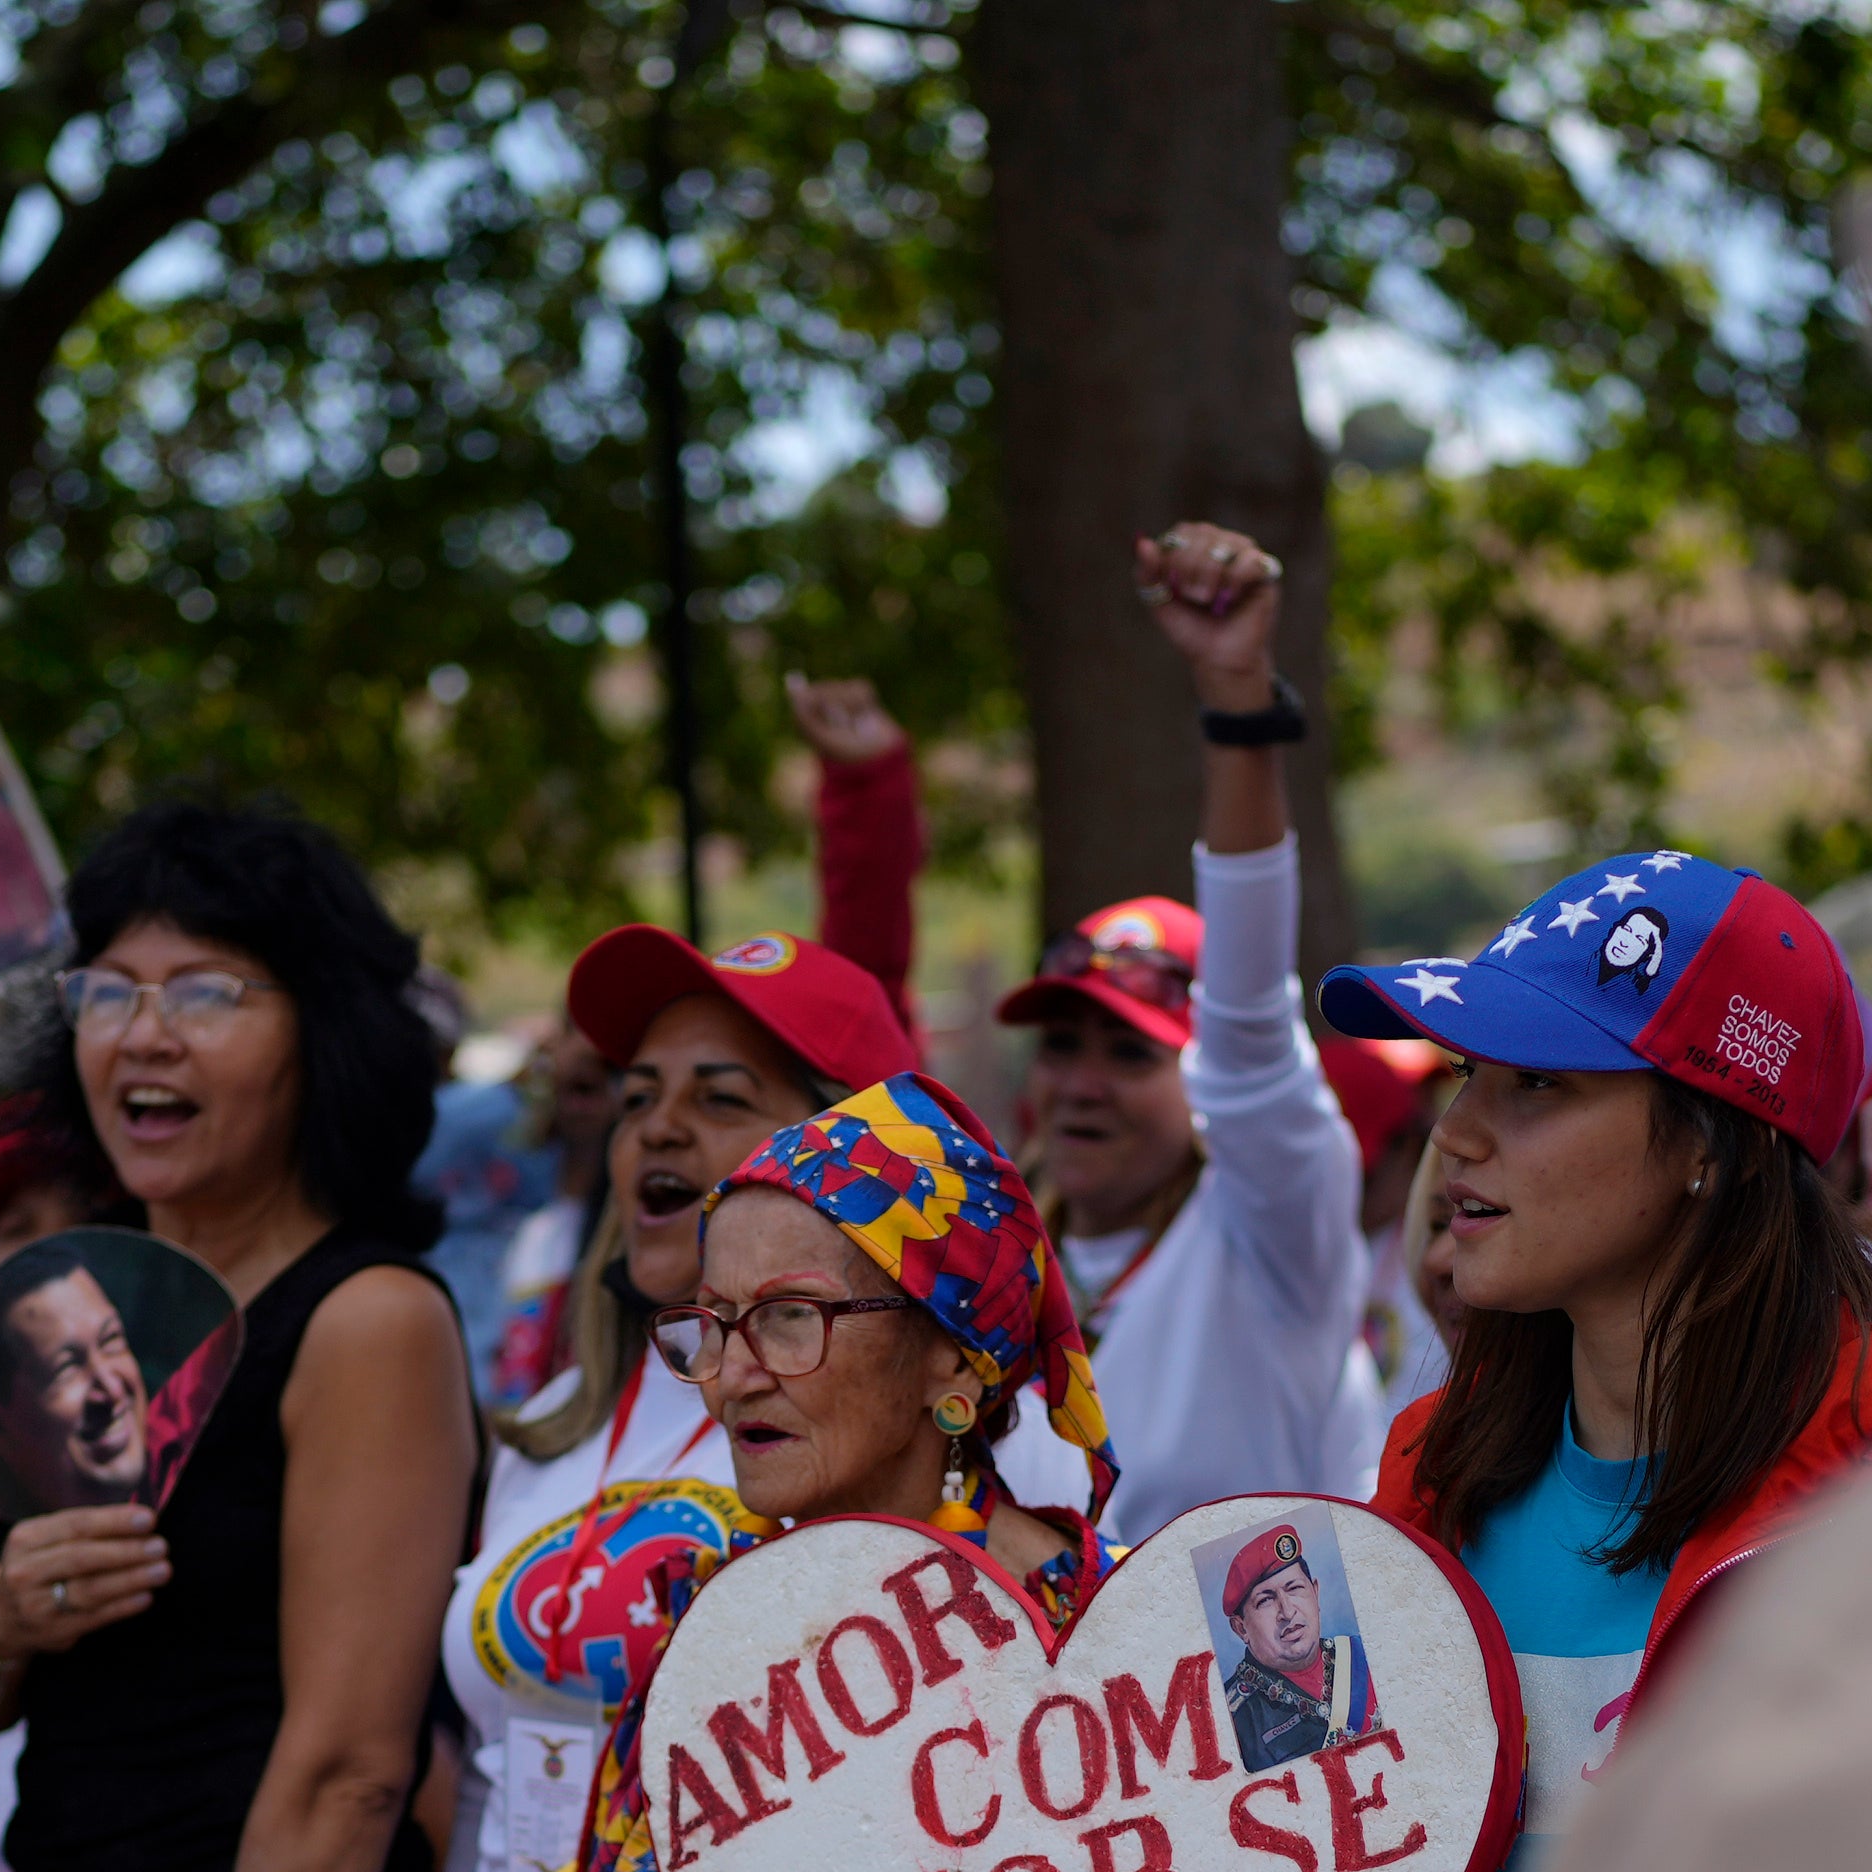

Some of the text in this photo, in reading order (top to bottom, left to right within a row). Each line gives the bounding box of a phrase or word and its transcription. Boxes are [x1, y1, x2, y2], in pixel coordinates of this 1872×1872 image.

[1721, 1015, 1790, 1066] SOMOS
[1728, 994, 1802, 1051] CHAVEZ
[1684, 1045, 1731, 1080] 1954
[1746, 1079, 1787, 1116] 2013
[1715, 1034, 1781, 1084] TODOS
[668, 1547, 1017, 1871] AMOR
[911, 1651, 1232, 1849] COM
